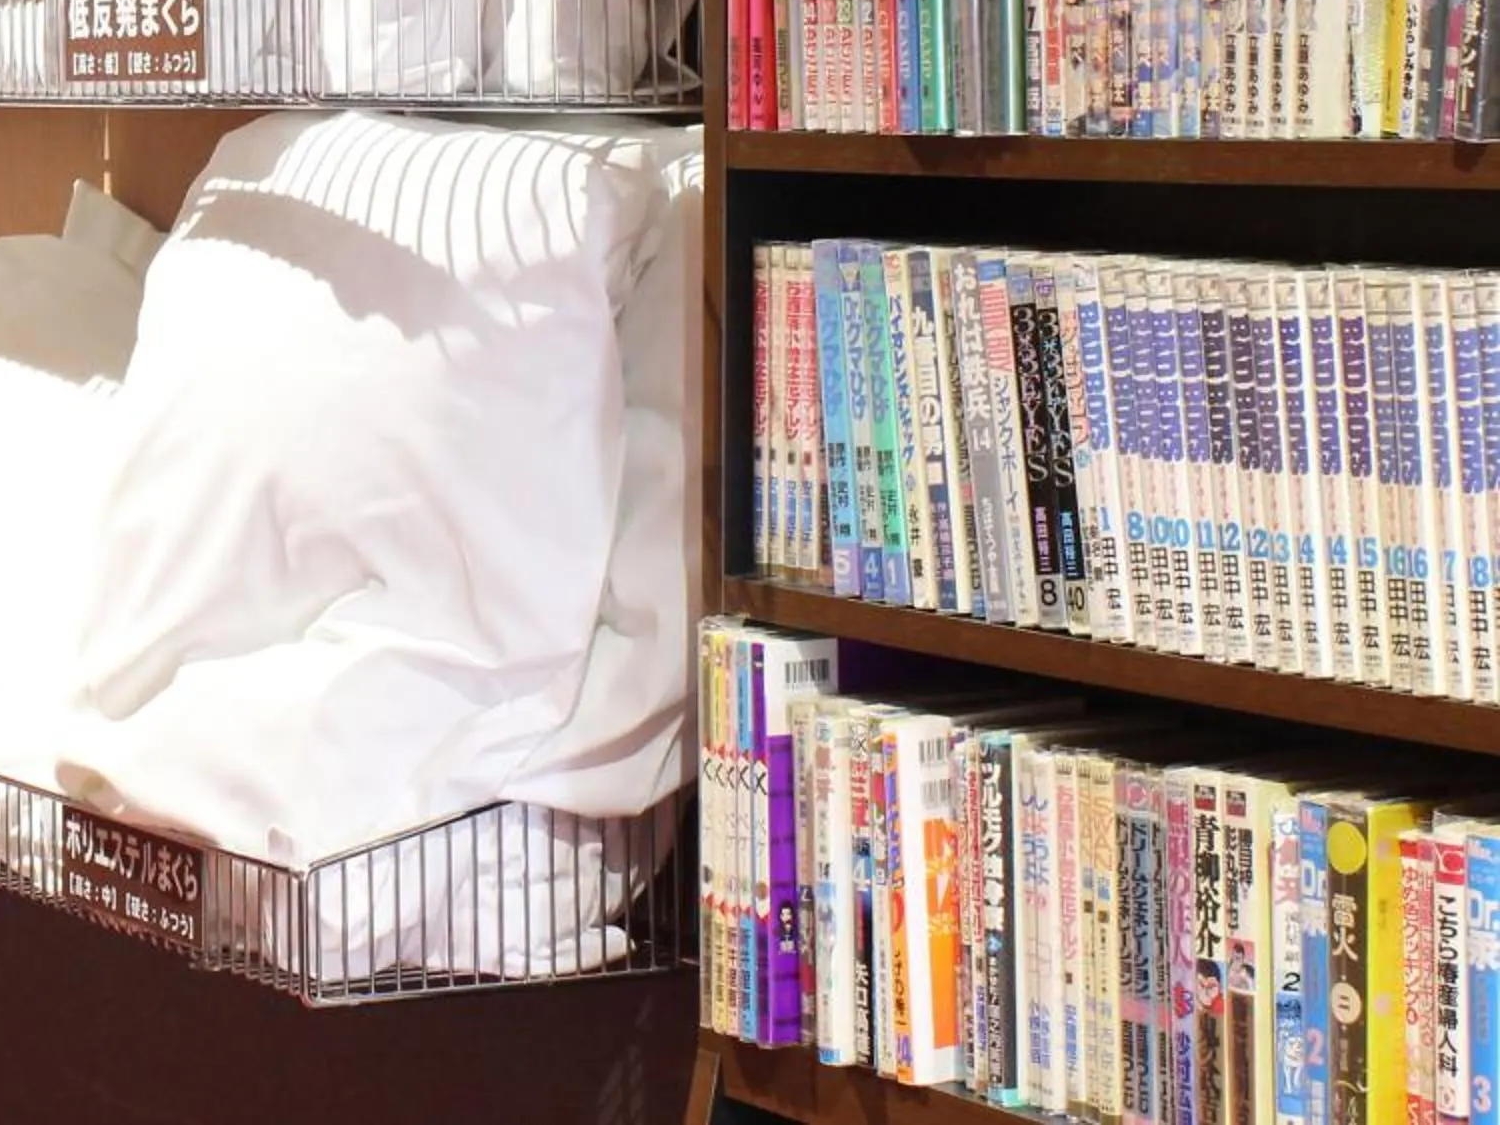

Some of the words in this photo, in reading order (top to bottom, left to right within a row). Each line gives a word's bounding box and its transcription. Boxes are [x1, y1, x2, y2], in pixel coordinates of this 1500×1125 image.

[972, 427, 991, 451] 14
[1126, 510, 1145, 540] 8
[1219, 522, 1241, 552] 12
[1246, 527, 1269, 558] 12
[1357, 537, 1379, 568] 15
[865, 552, 877, 579] 4
[1040, 579, 1057, 607] 8
[65, 815, 198, 903] ポリエステルまくら
[125, 891, 194, 940] 【硬さ：ふつう】
[1282, 972, 1300, 992] 2
[1307, 1027, 1325, 1066] 2
[1473, 1077, 1492, 1114] 3
